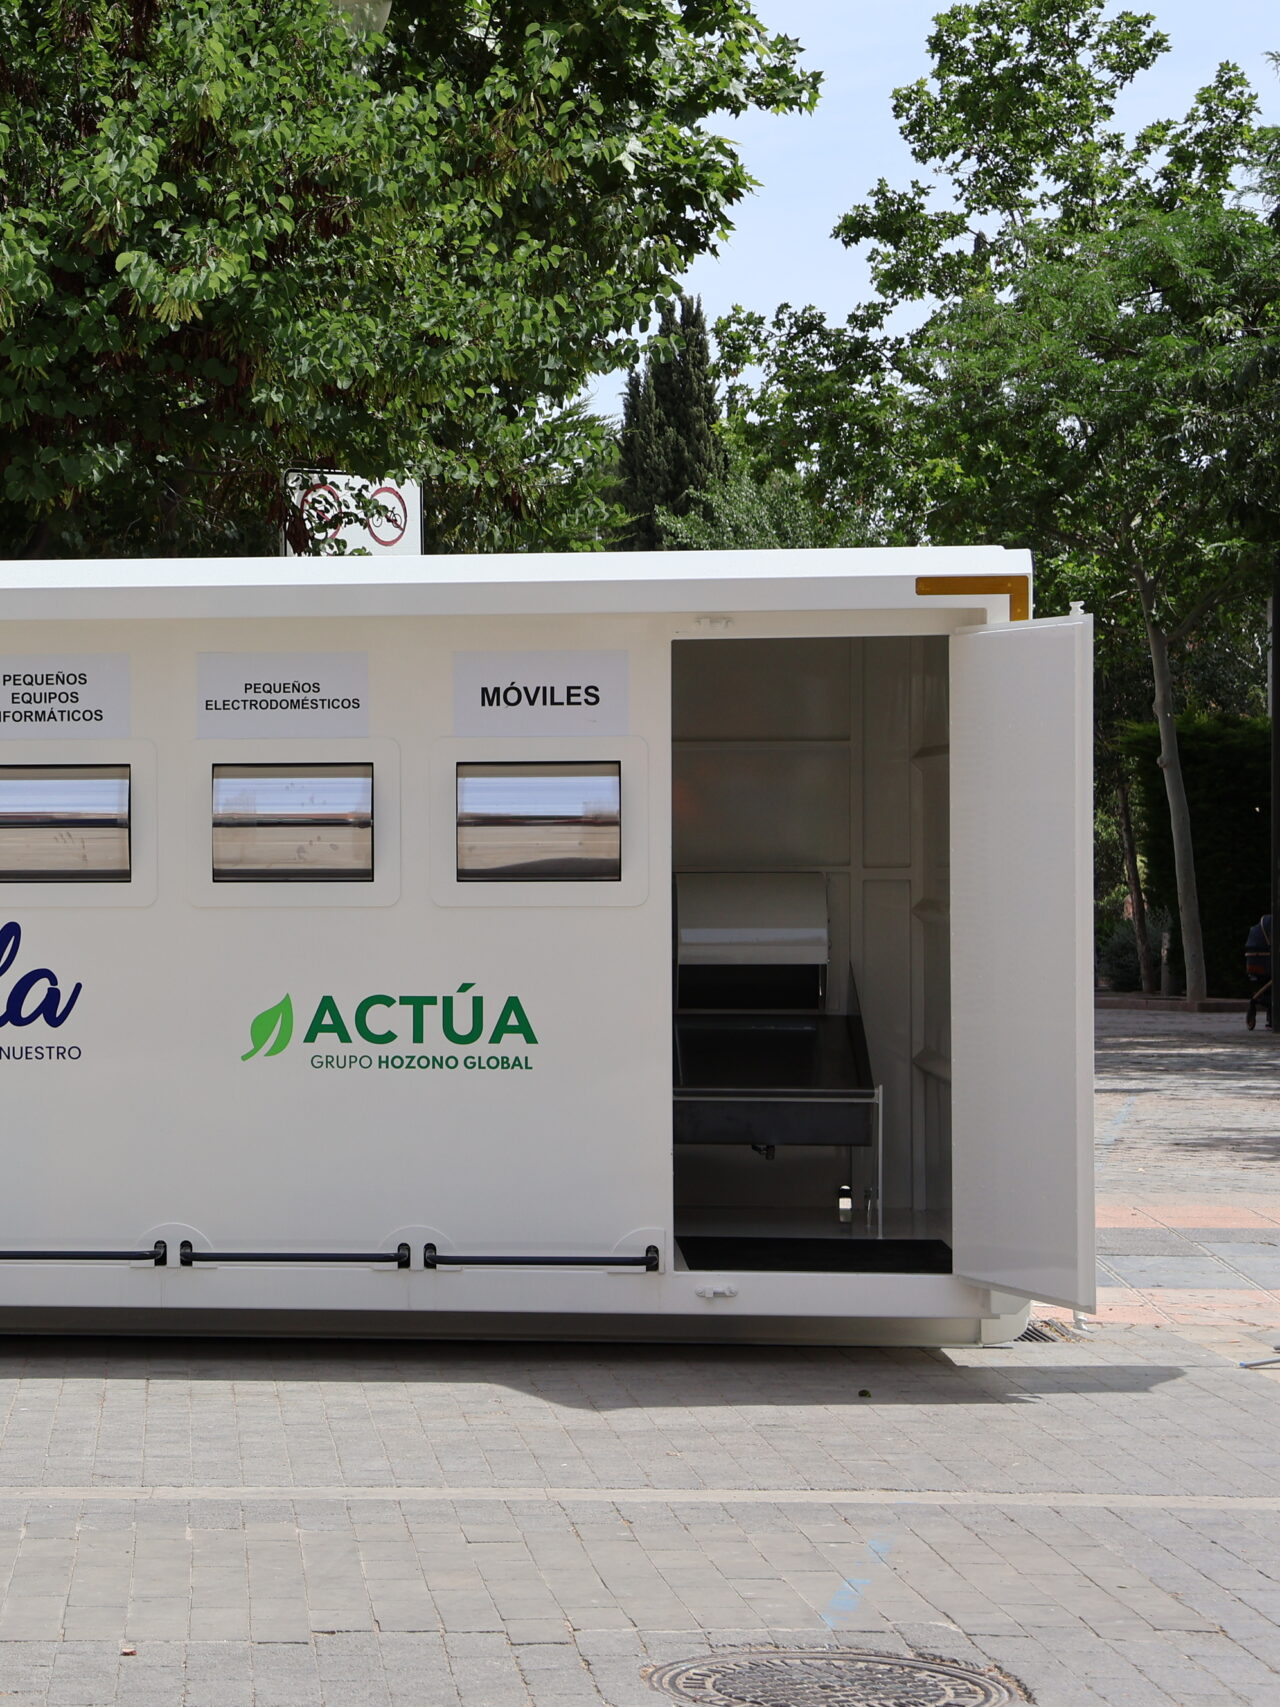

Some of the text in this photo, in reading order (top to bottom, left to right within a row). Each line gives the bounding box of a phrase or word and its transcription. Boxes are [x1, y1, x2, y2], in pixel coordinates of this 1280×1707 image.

[2, 671, 88, 688] PEQUEÑOS
[244, 680, 321, 696] PEQUEÑOS
[480, 682, 601, 707] MÓVILES
[11, 691, 80, 706] EQUIPOS
[205, 696, 361, 711] ELECTRODOMÉSTICOS
[303, 983, 539, 1045] ACTÚA
[0, 1046, 82, 1061] NUESTRO
[310, 1054, 533, 1070] GRUPO HOZONO GLOBAL
